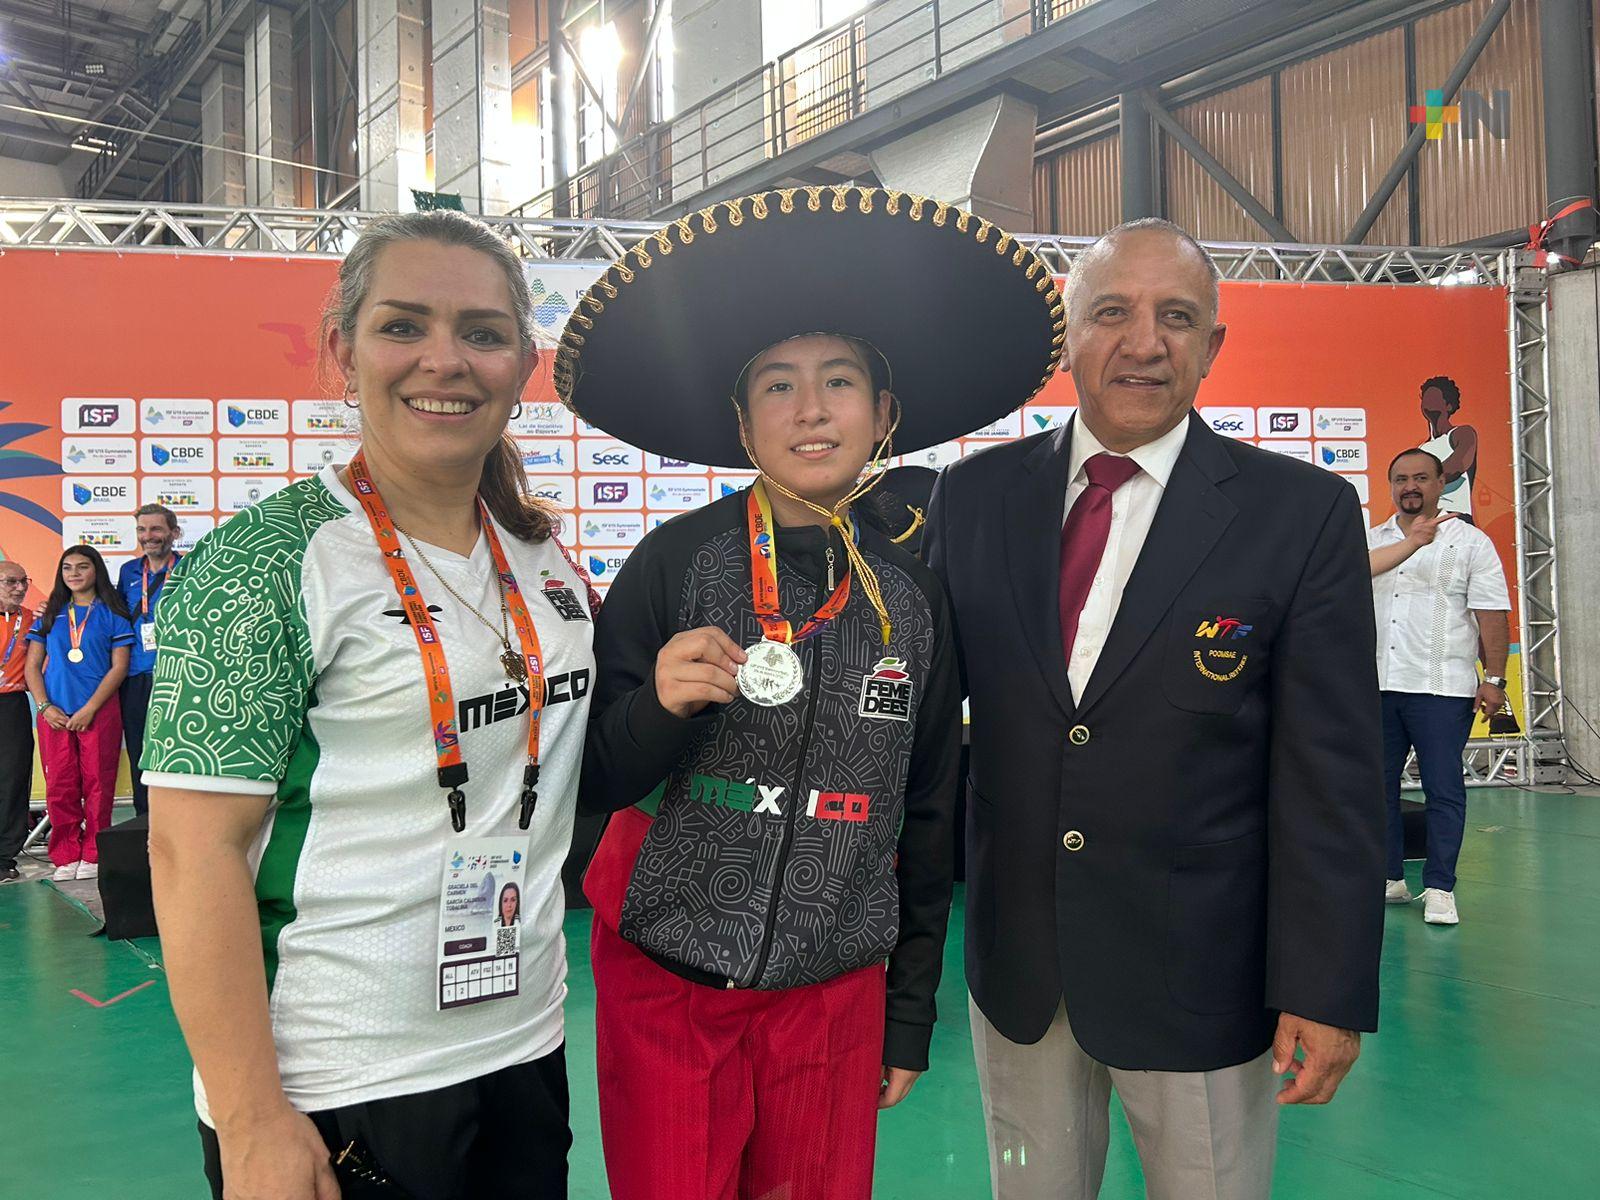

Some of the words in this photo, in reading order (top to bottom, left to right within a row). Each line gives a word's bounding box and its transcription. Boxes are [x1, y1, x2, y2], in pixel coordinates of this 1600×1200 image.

[83, 408, 114, 424] ISF
[247, 409, 278, 420] CBDE
[1213, 419, 1244, 431] Sesc
[1272, 416, 1295, 430] ISF
[171, 447, 204, 458] CBDE
[592, 452, 629, 465] Sesc
[1336, 449, 1360, 458] CBDE
[93, 486, 126, 497] CBDE
[358, 479, 372, 494] ISF
[595, 485, 626, 500] ISF
[754, 513, 764, 533] CBDE
[420, 626, 434, 642] ISF
[1195, 615, 1253, 640] WTF
[1208, 649, 1237, 659] POOMSAE
[529, 656, 539, 673] ISF
[1193, 650, 1230, 681] INTERNATIONAL
[867, 682, 911, 699] FEME
[863, 696, 909, 714] DEES
[444, 925, 466, 933] MEXICO
